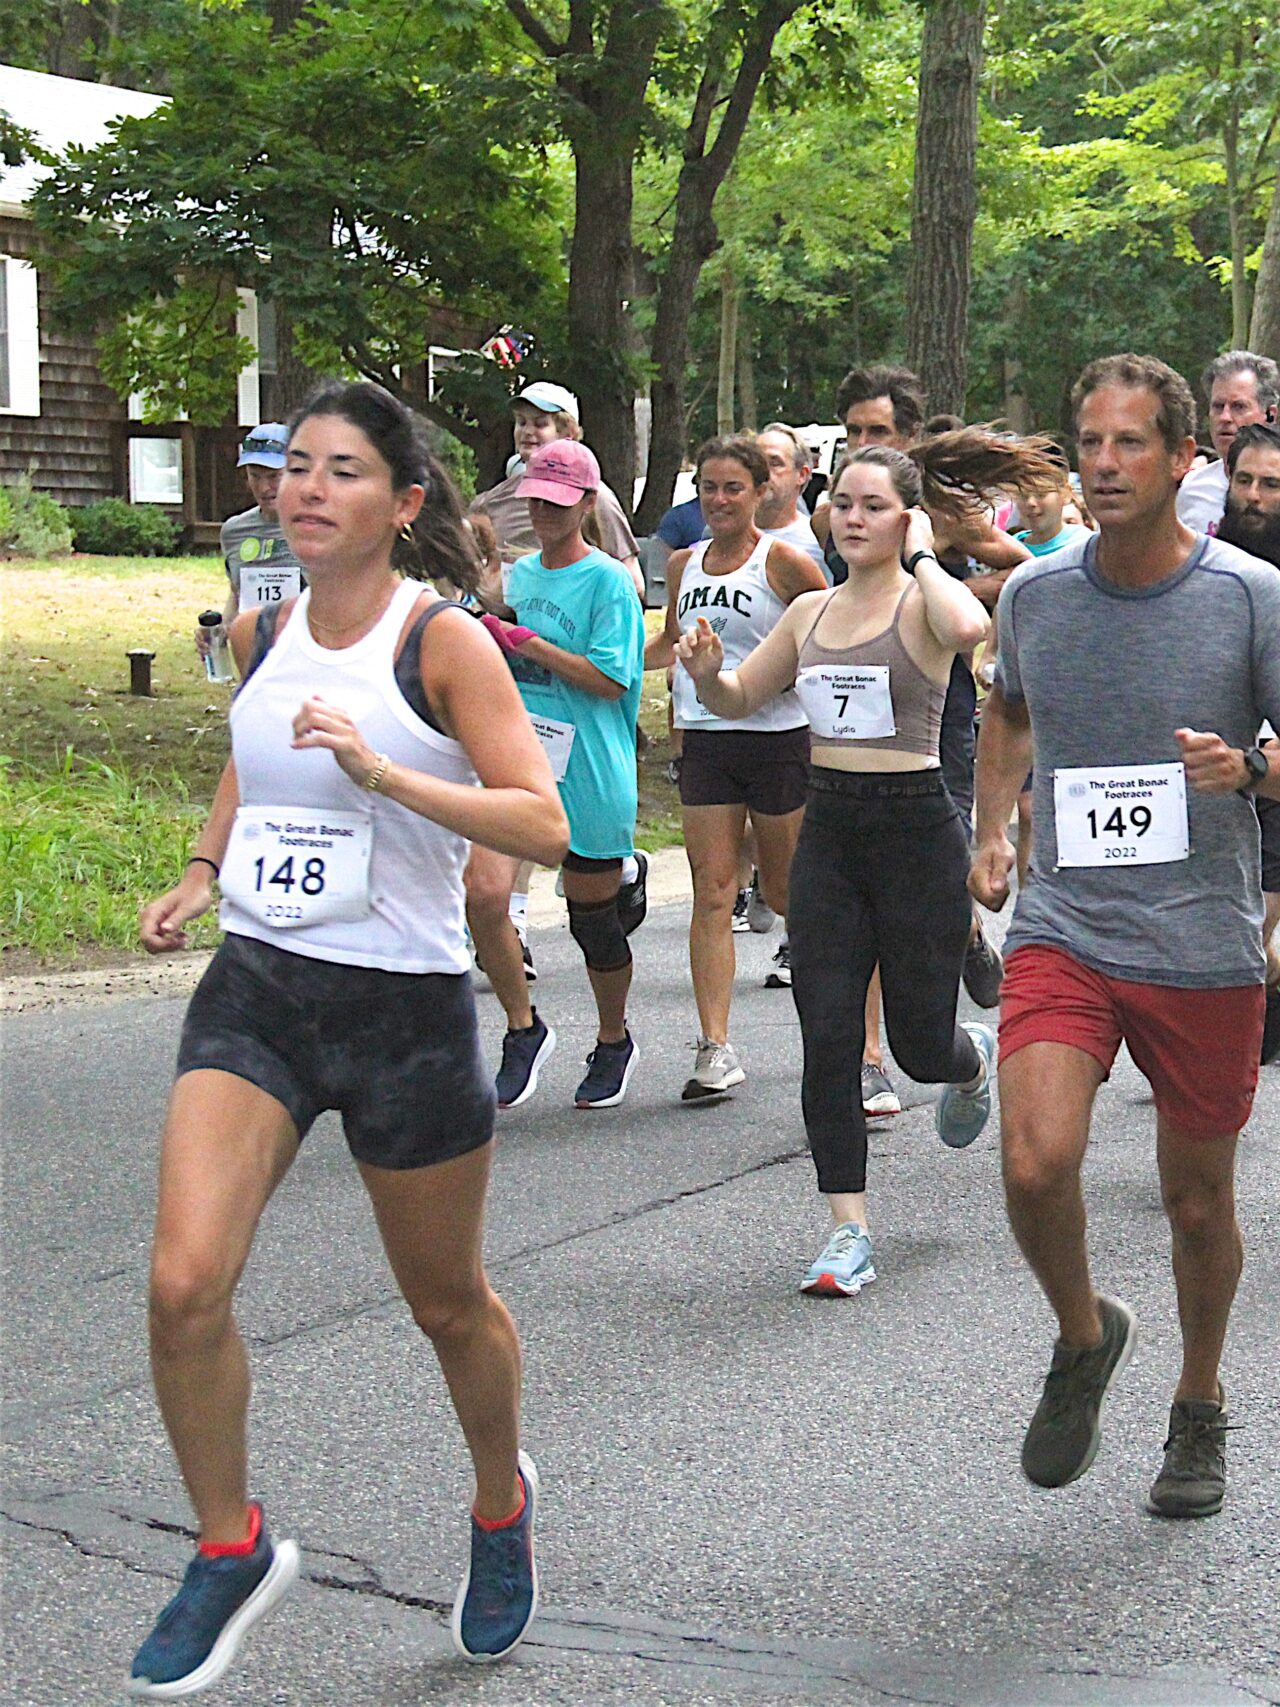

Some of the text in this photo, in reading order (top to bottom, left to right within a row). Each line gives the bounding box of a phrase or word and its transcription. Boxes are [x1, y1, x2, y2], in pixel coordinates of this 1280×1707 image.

[258, 586, 282, 601] 113
[834, 694, 849, 718] 7
[832, 725, 856, 734] Lydia
[1090, 778, 1168, 789] The Great Bonac
[1104, 790, 1152, 799] Footraces
[265, 822, 354, 837] The Great Bonac
[1087, 805, 1152, 839] 149
[279, 836, 334, 848] Footraces
[1104, 847, 1137, 858] 2022
[254, 856, 326, 896] 148
[266, 904, 303, 919] 2022
